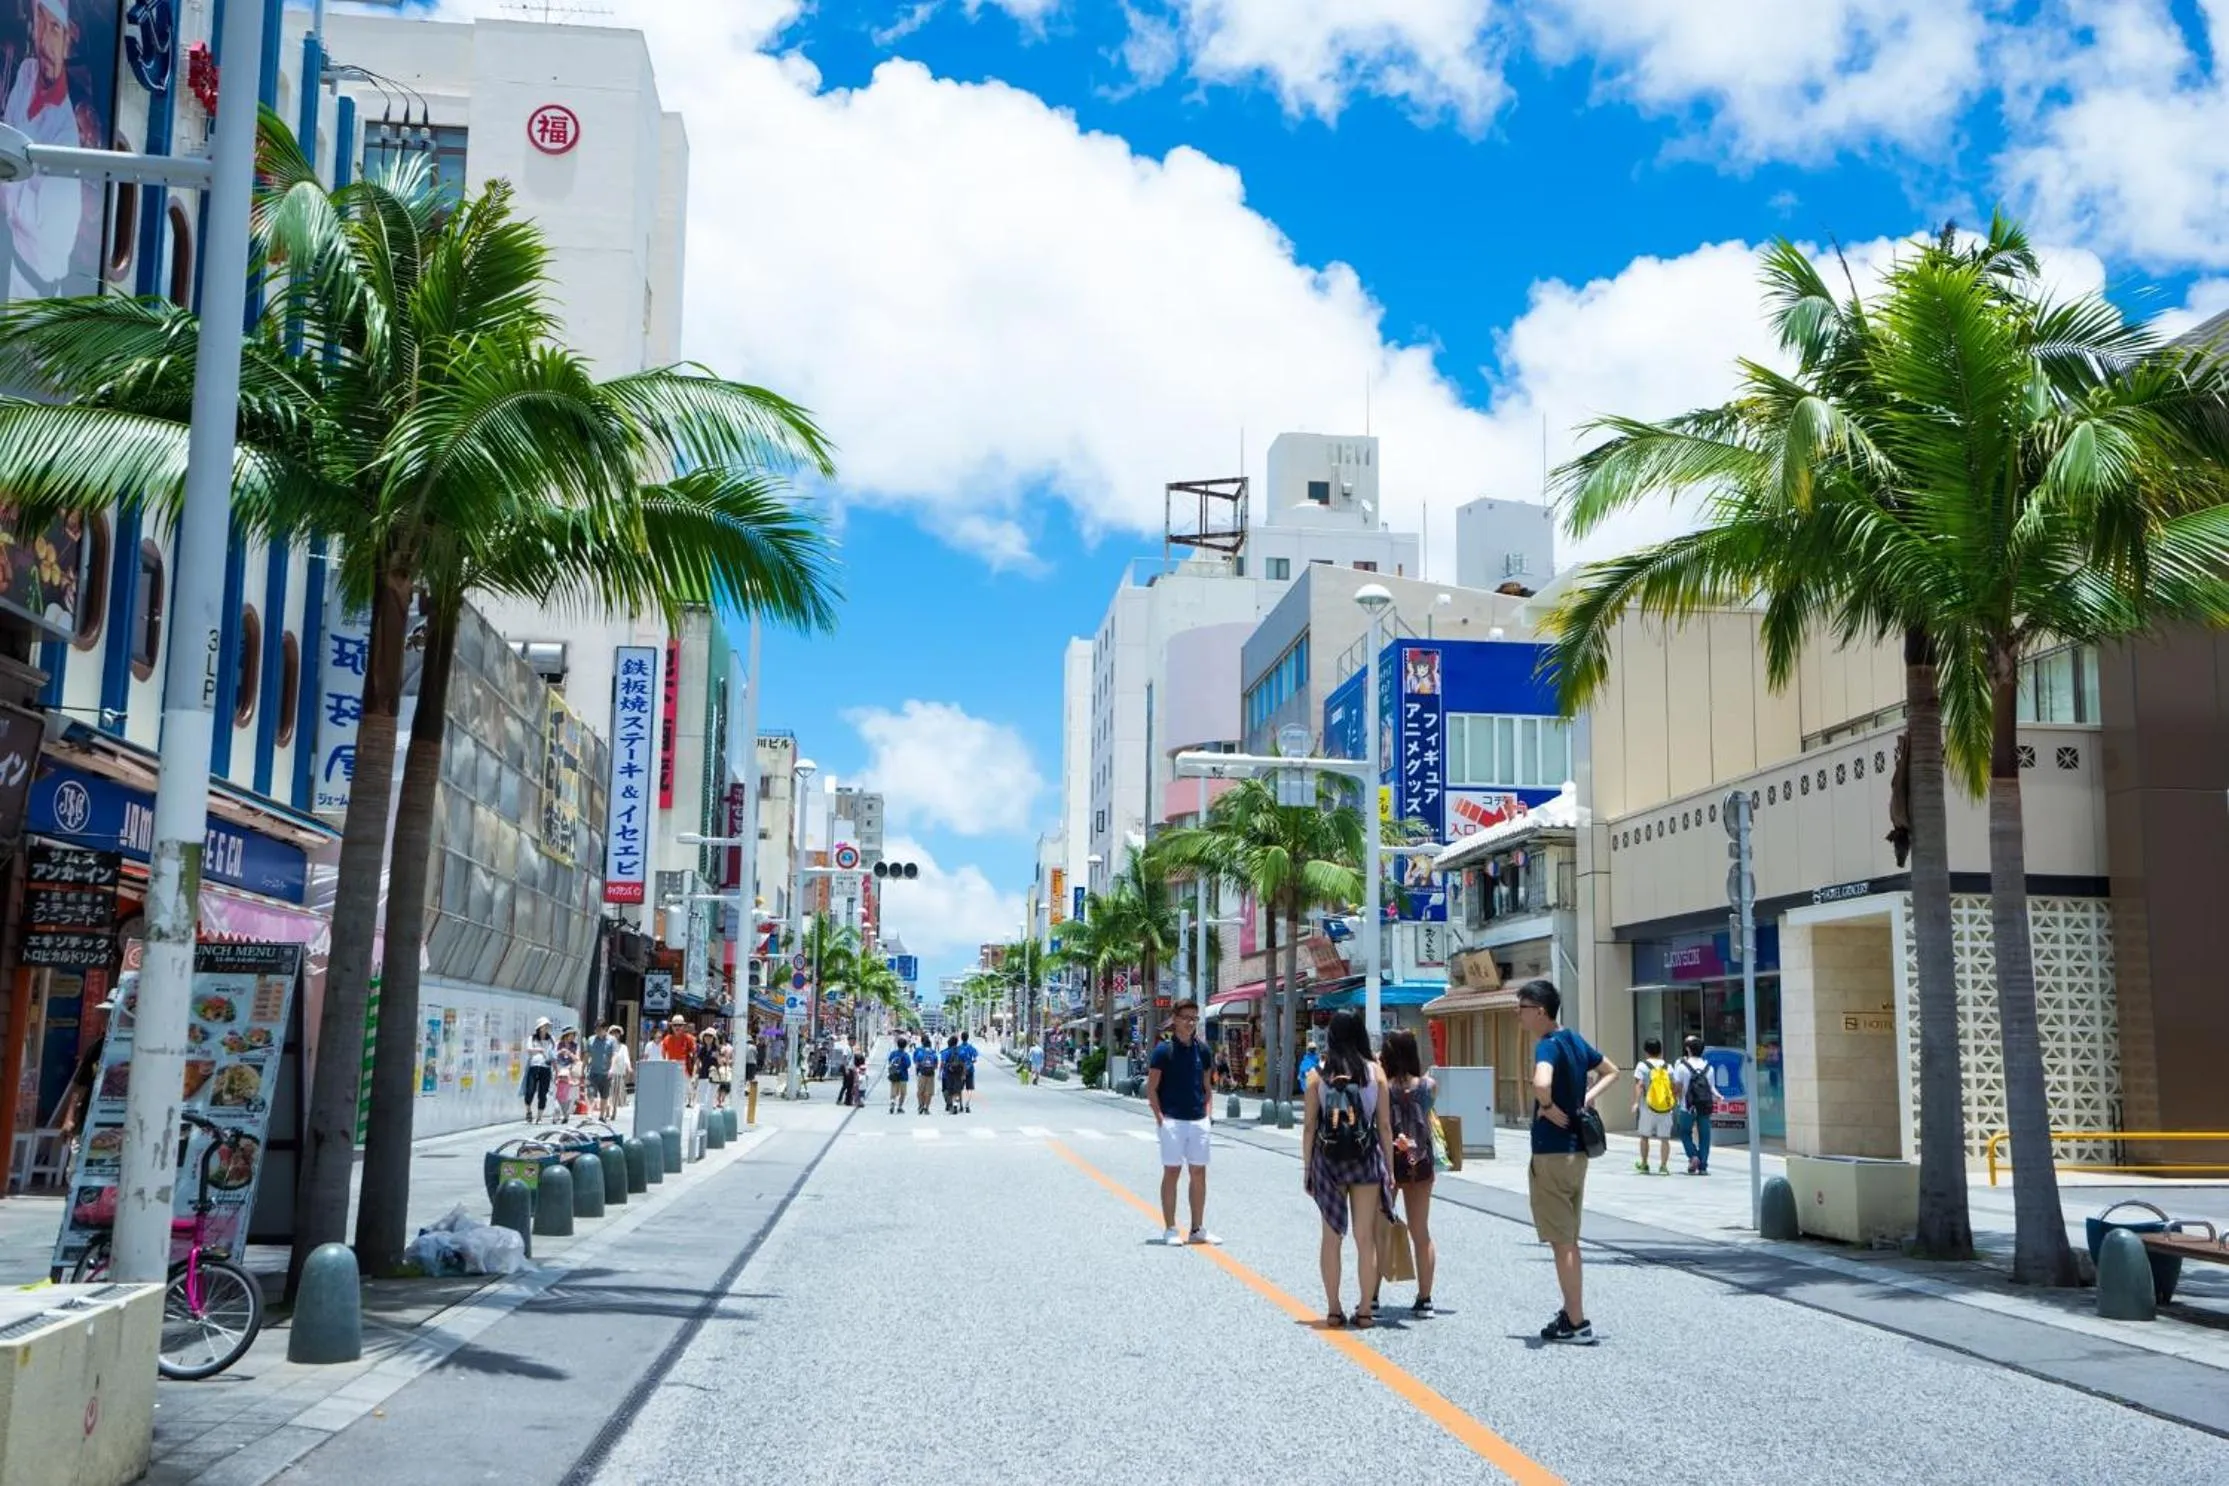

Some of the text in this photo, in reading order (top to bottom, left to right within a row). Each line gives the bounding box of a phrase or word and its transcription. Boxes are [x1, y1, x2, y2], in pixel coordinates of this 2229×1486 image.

[537, 115, 568, 144] 福
[1405, 702, 1421, 814] アニメグッズ
[1423, 713, 1439, 804] フィギュア
[119, 801, 154, 854] JAM
[1450, 823, 1477, 836] 入口
[32, 862, 113, 884] アンカーイン
[194, 945, 231, 957] UNCH
[235, 946, 277, 958] MENU
[1663, 947, 1701, 969] LAWSON
